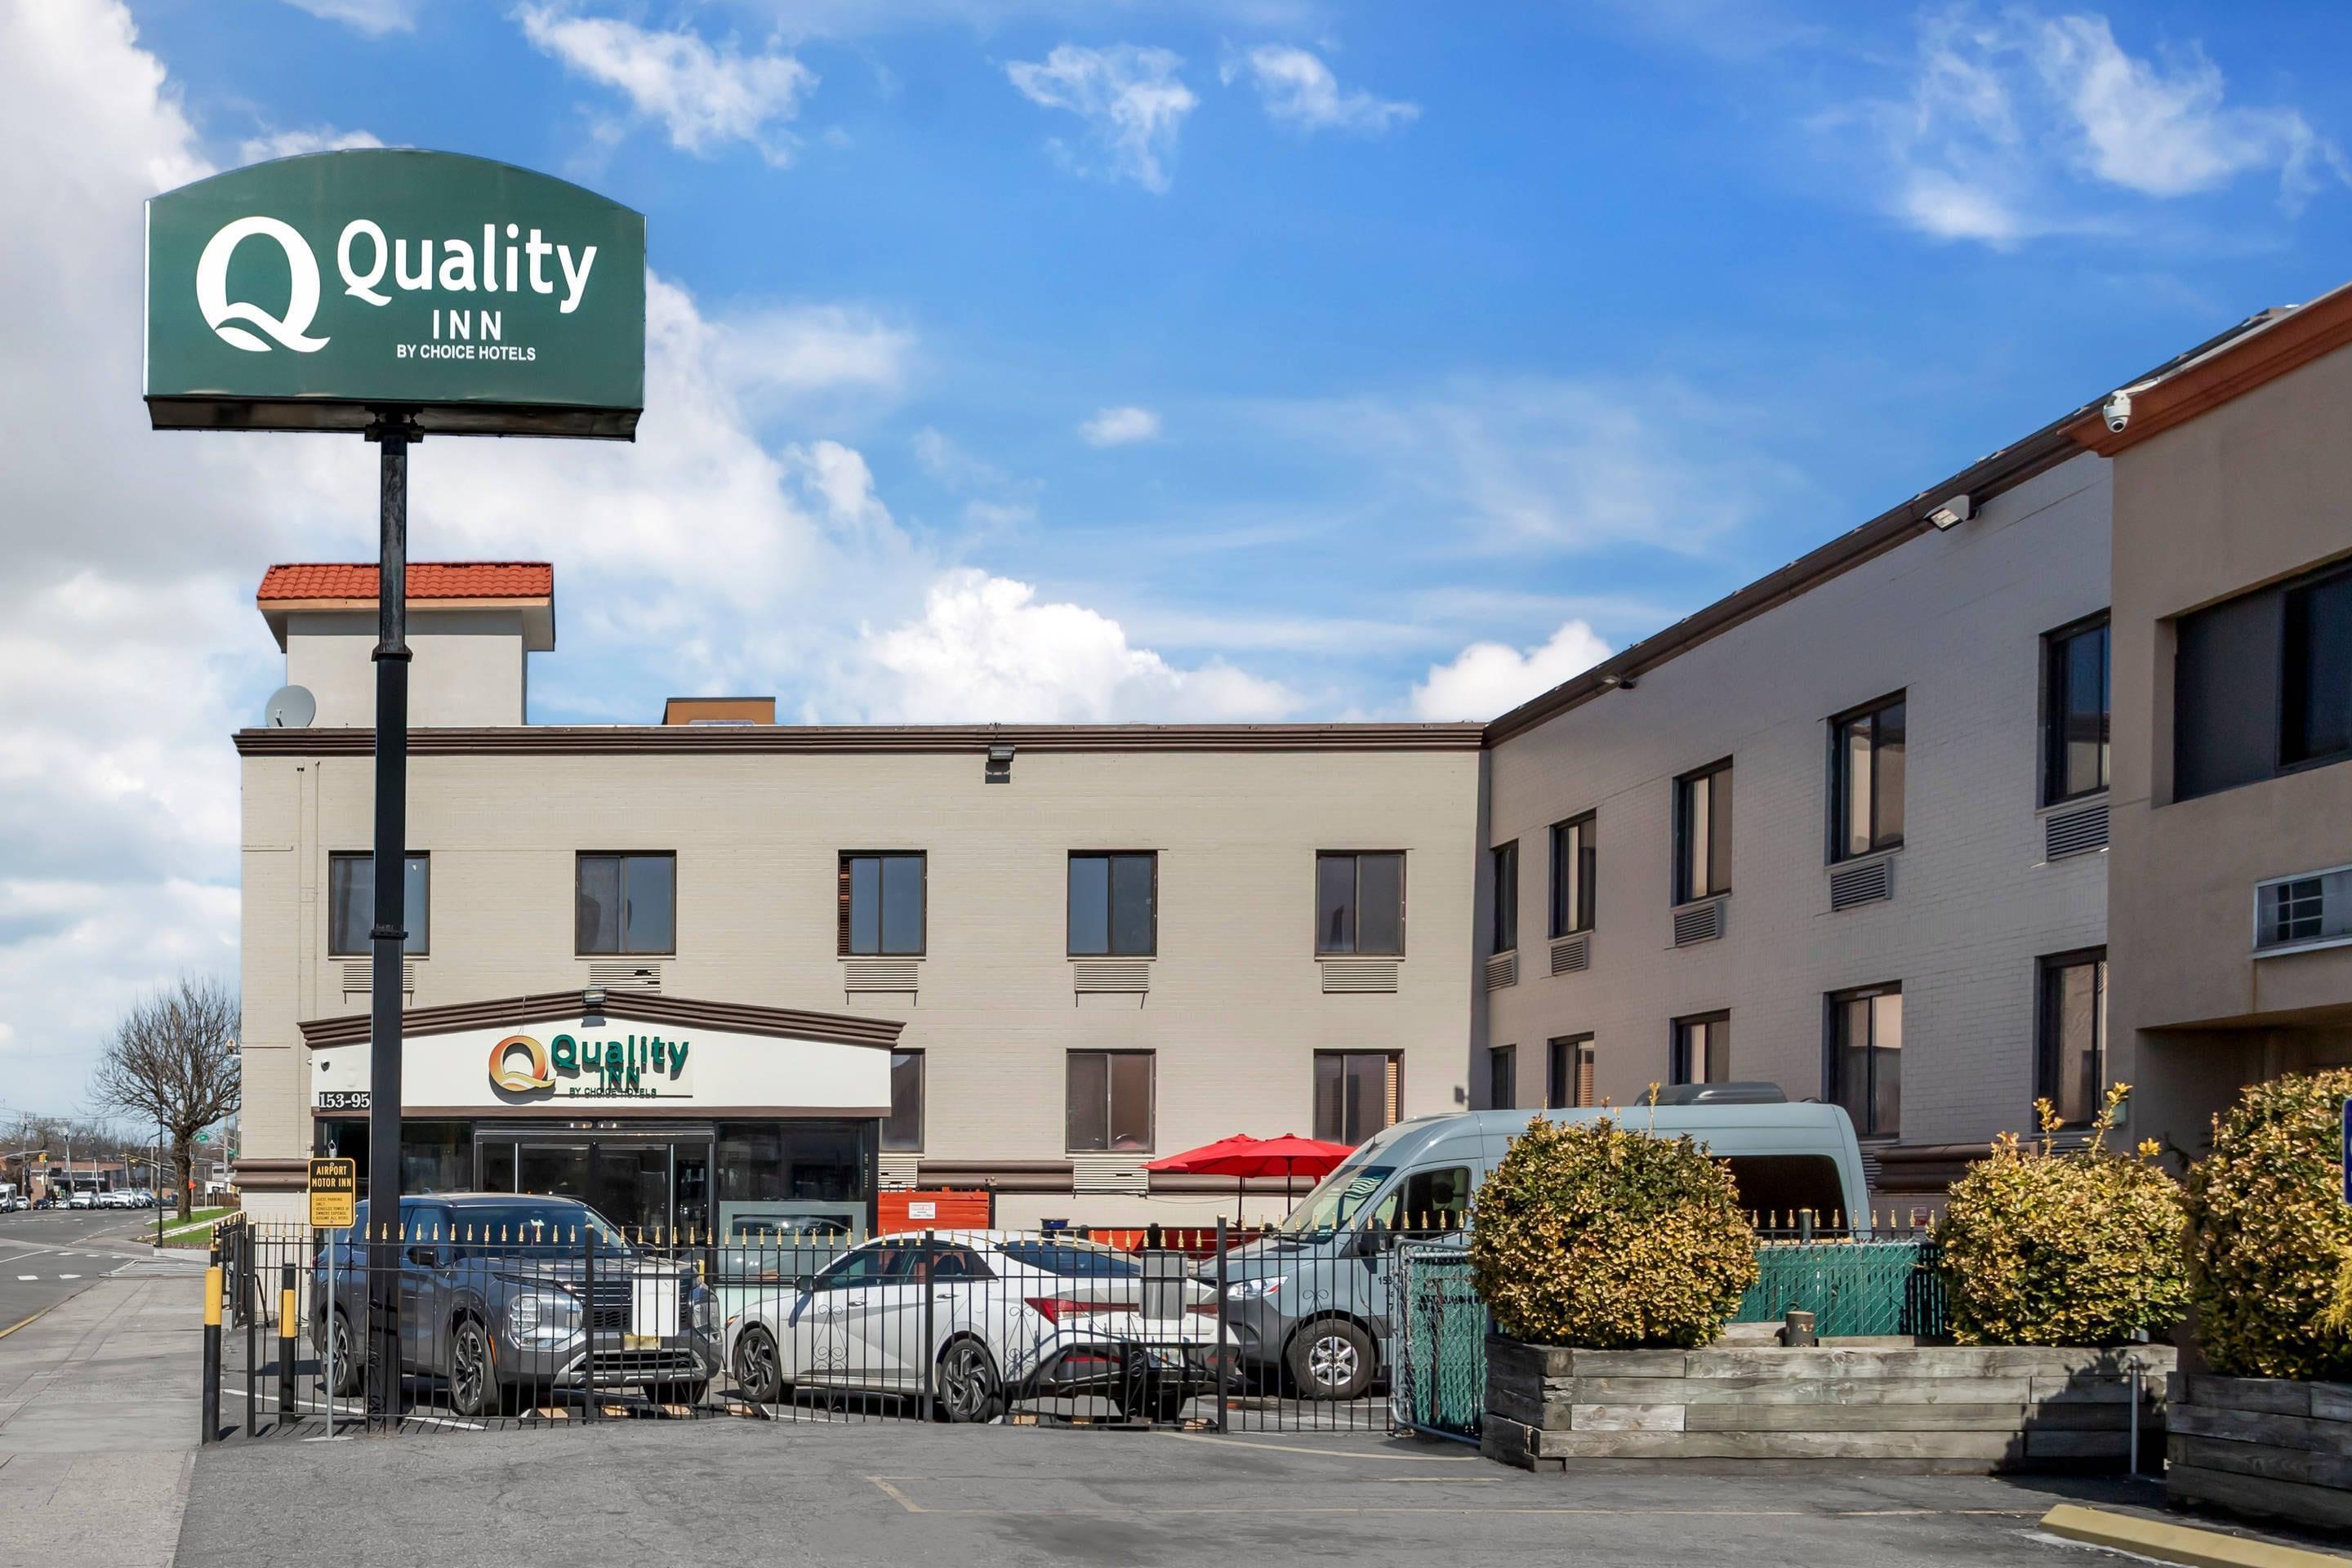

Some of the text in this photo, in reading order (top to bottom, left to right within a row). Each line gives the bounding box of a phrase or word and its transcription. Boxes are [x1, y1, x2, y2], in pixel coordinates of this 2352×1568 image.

[336, 219, 598, 314] Quality
[196, 216, 331, 353] Q
[432, 310, 502, 341] INN
[396, 344, 537, 361] BY CHOICE HOTELS
[551, 1034, 689, 1072] Quality
[488, 1035, 556, 1092] Q
[599, 1067, 640, 1085] INN
[319, 1093, 371, 1108] 153-95
[569, 1087, 657, 1096] BY CHOICE HOTELS
[316, 1165, 347, 1175] AIRPORT
[312, 1178, 352, 1187] MOTOR INN
